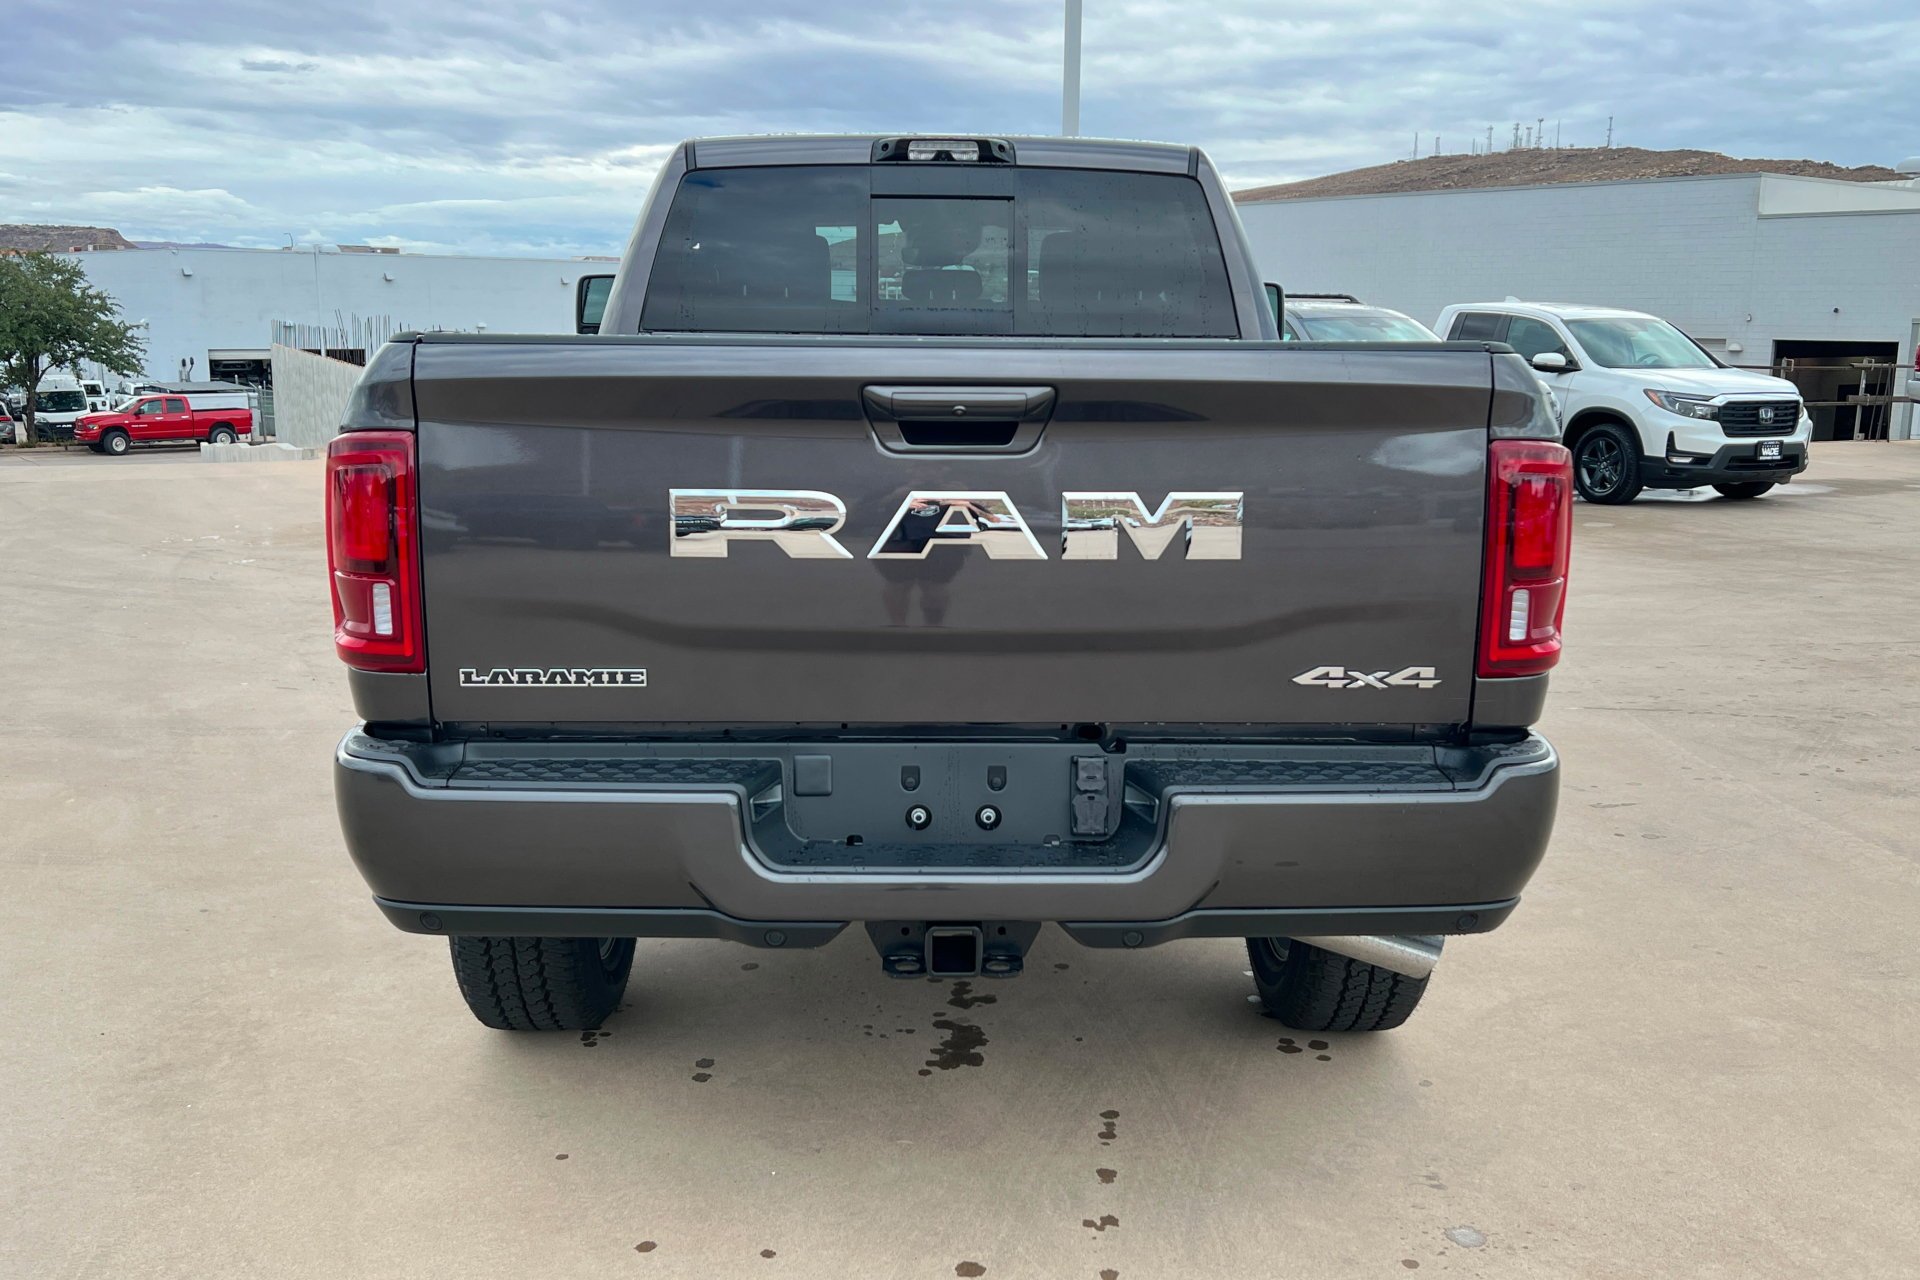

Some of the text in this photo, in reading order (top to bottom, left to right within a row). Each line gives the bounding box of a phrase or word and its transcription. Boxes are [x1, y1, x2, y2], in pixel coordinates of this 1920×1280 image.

[1761, 447, 1779, 455] WADE
[669, 488, 1244, 560] RAM
[459, 668, 647, 687] LARAMIE
[1291, 666, 1442, 690] 4x4
